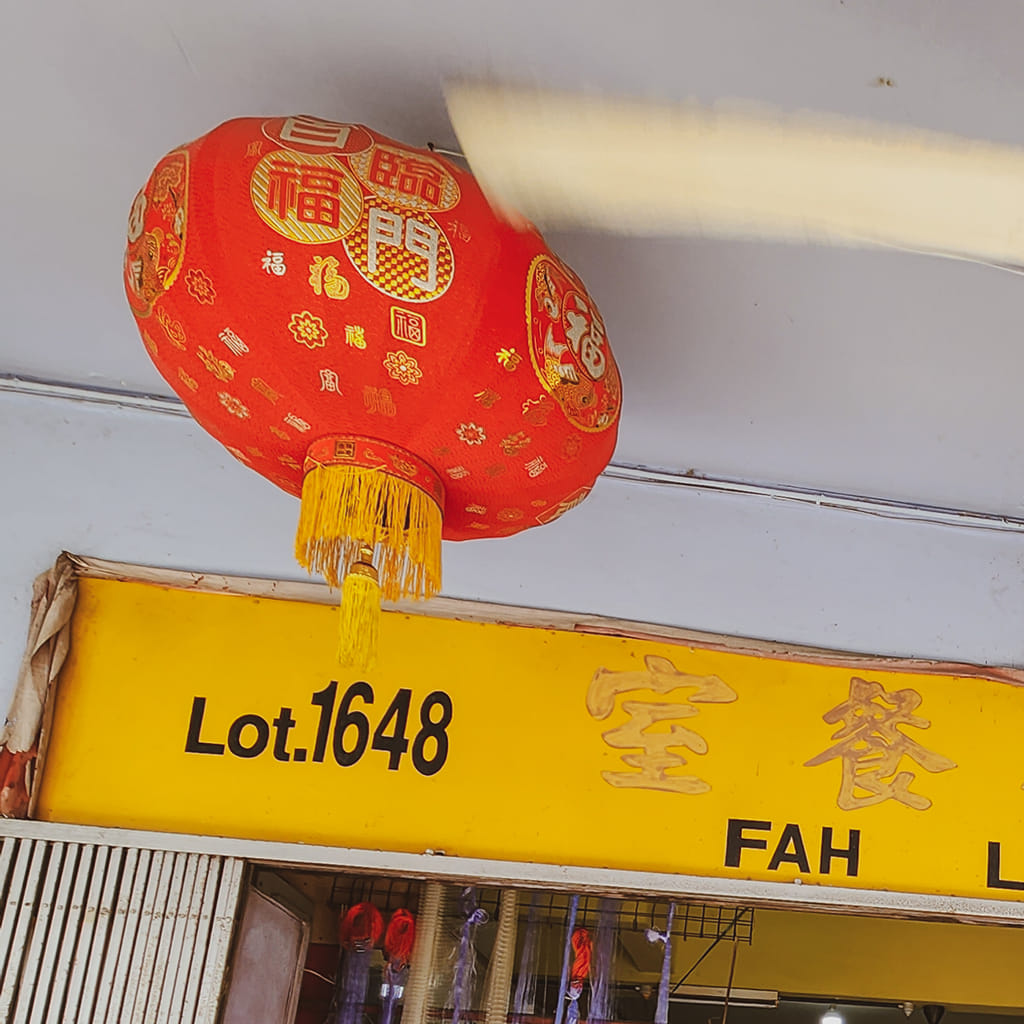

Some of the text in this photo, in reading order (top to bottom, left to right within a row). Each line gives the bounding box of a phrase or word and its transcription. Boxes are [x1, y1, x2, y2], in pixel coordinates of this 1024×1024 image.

[266, 159, 345, 230] 福
[367, 206, 440, 292] 門
[185, 680, 454, 777] Lot.1648
[724, 818, 862, 878] FAH
